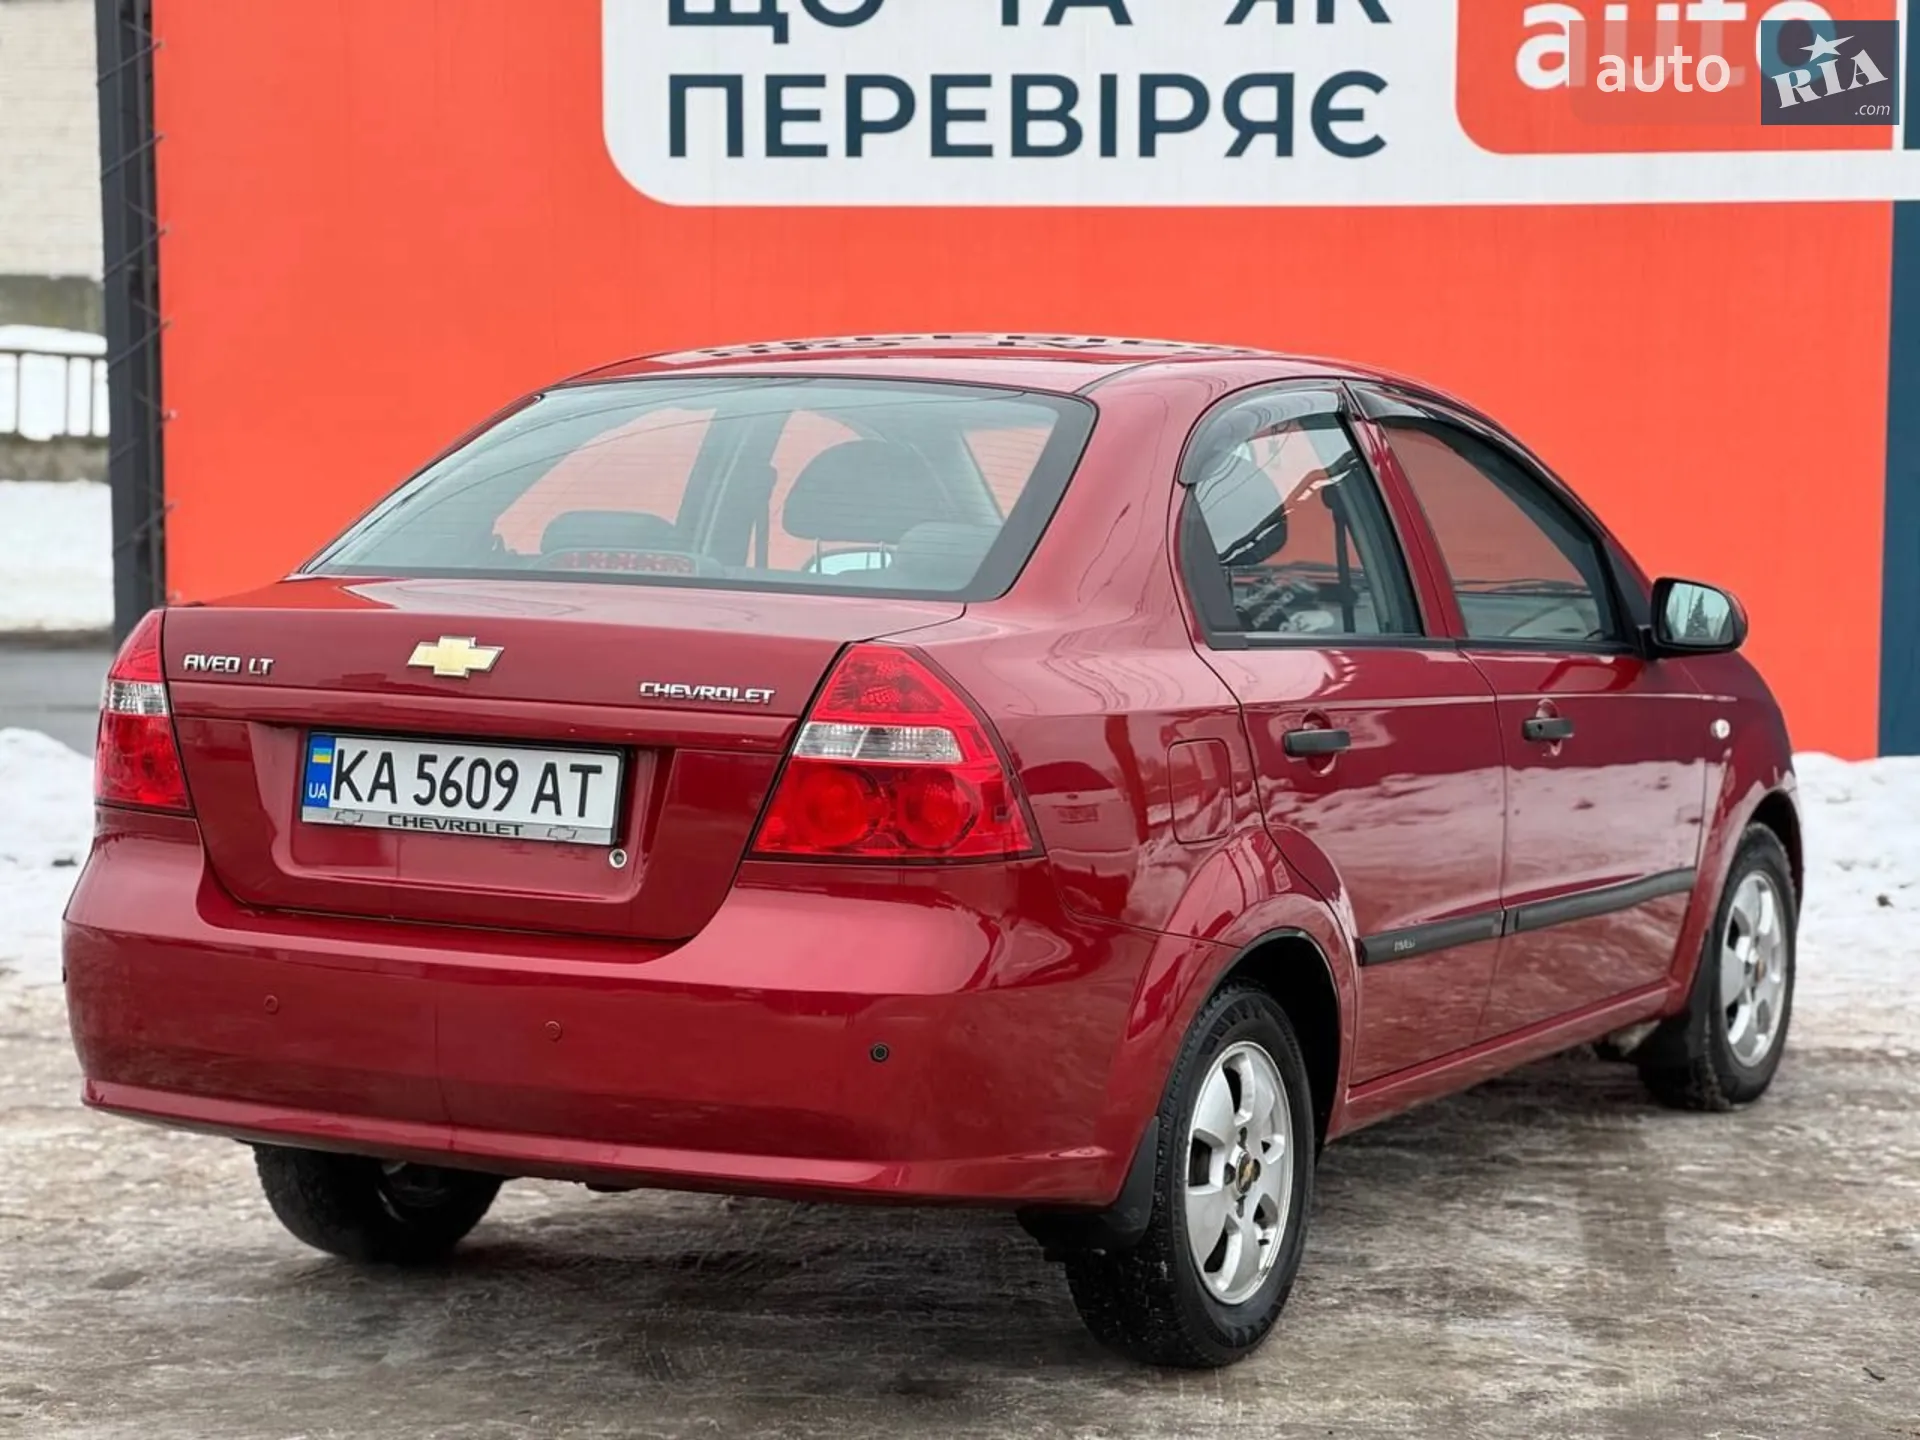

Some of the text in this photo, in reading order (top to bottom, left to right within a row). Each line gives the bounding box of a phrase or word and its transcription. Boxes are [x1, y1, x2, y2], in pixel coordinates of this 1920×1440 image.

[1515, 0, 1837, 90] auto
[668, 70, 1388, 158] ПЕРЕВІРЯЄ
[183, 654, 275, 675] AVEO LT
[639, 681, 776, 704] CHEVROLET
[307, 782, 328, 801] UA
[332, 748, 603, 818] KA 5609 AT
[387, 814, 524, 837] CHEVROLET
